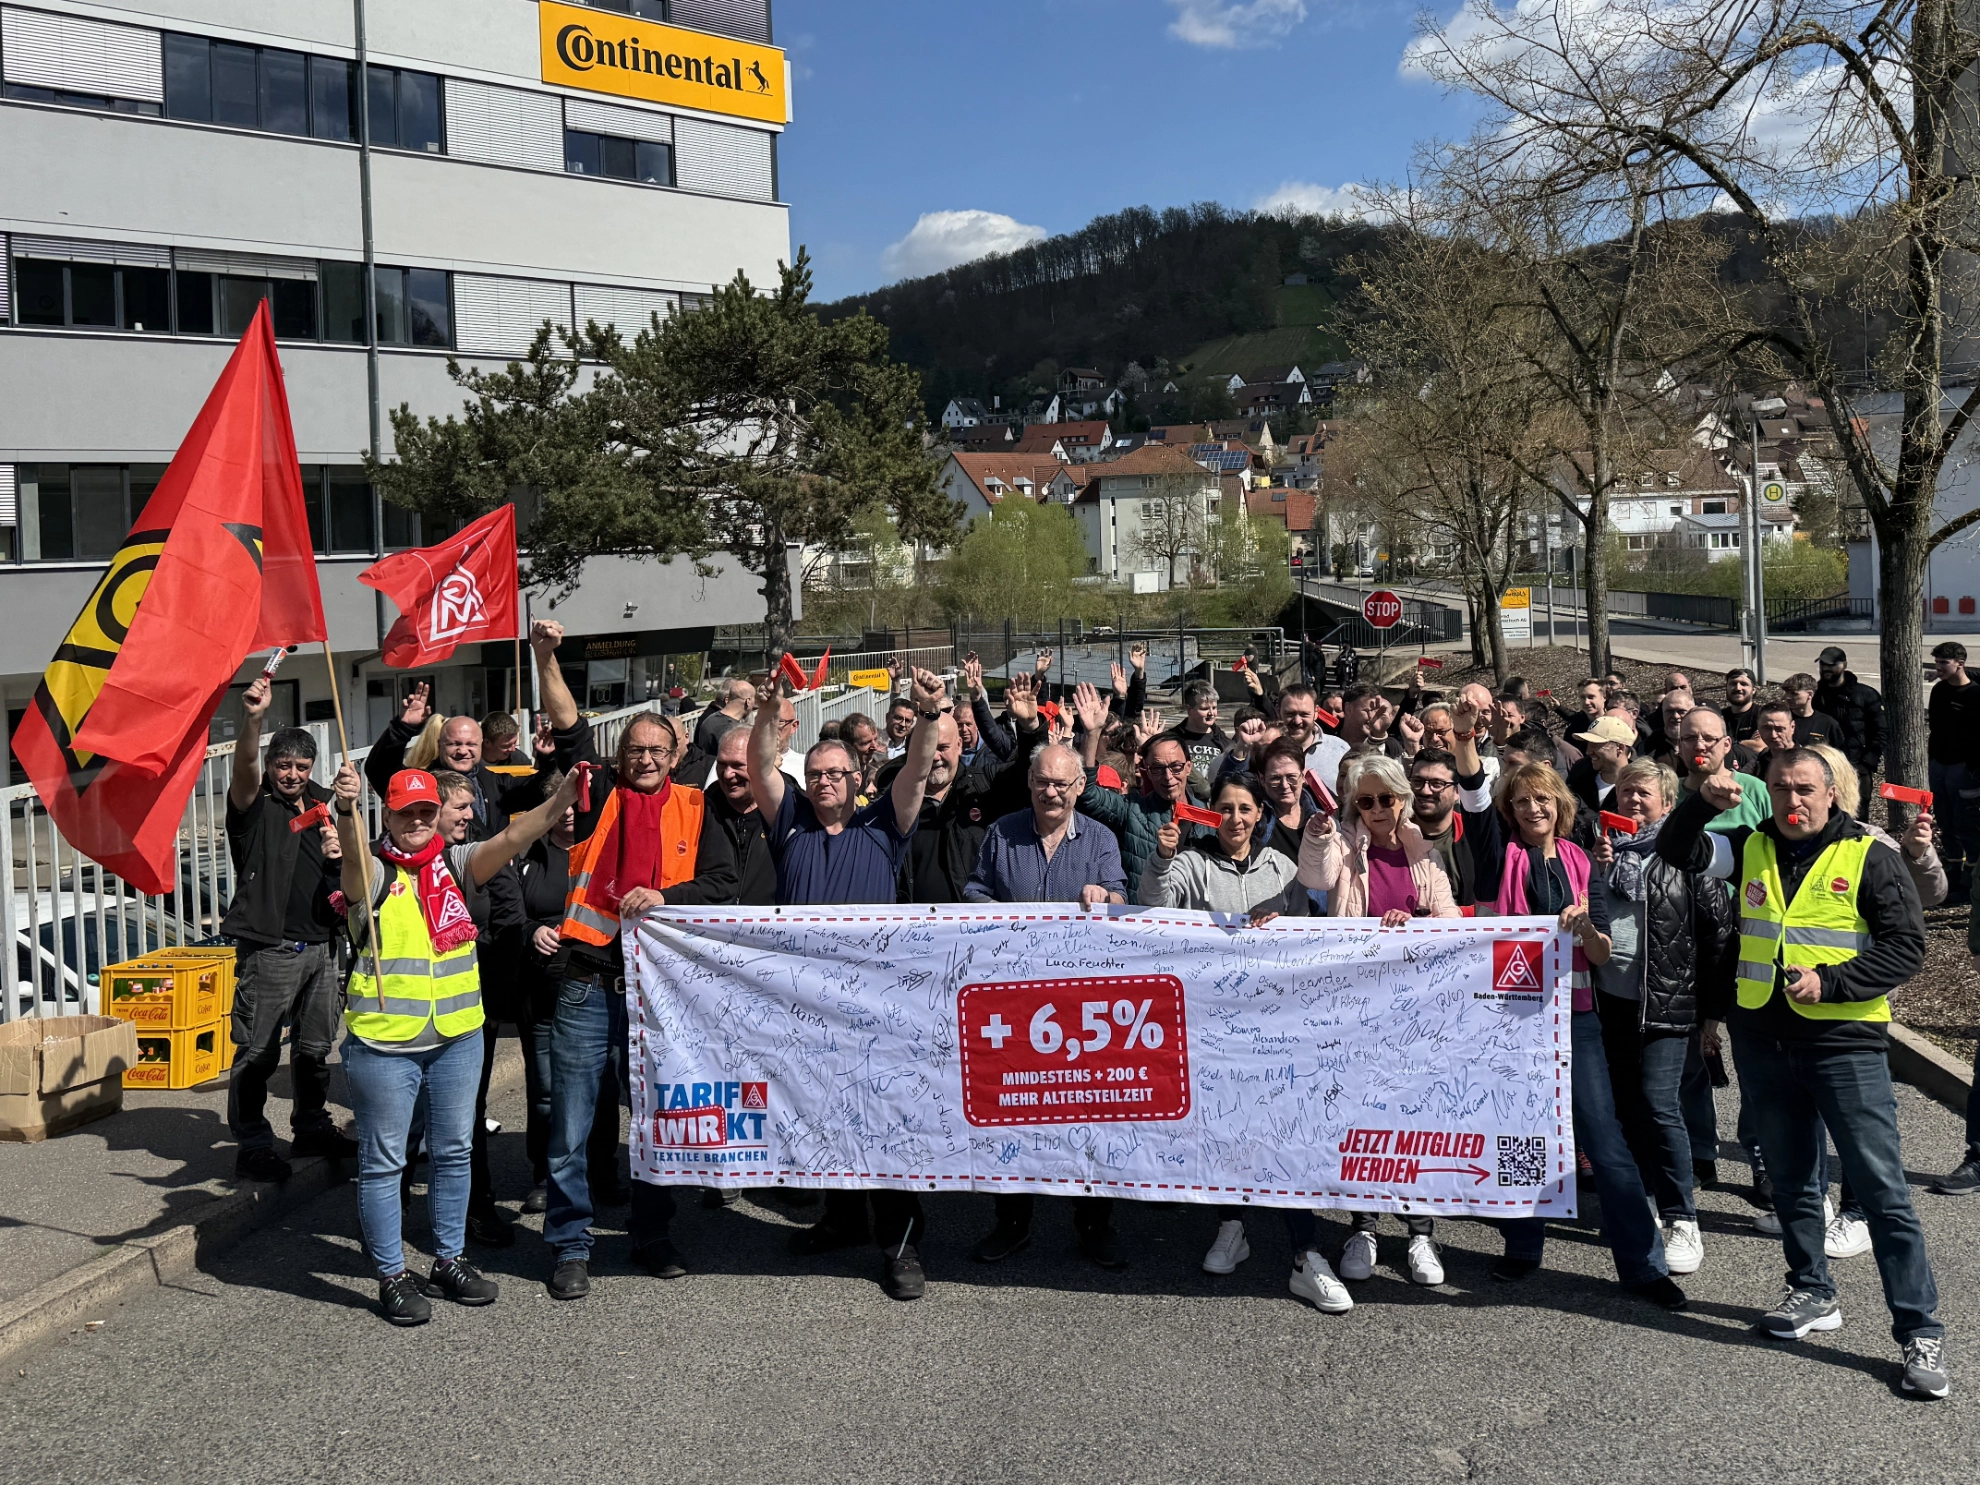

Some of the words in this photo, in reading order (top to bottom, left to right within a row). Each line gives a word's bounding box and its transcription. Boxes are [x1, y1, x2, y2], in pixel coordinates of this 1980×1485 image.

[556, 24, 743, 91] Continental
[1769, 488, 1778, 497] H
[1367, 601, 1399, 617] STOP
[585, 639, 636, 650] ANMELDUNG
[853, 672, 880, 681] Continental
[1046, 958, 1075, 968] Luca
[1079, 957, 1125, 970] Feuchter
[1292, 970, 1347, 995] Leander
[1474, 993, 1543, 1002] Baden-Württemberg
[129, 1007, 168, 1020] Coca-Cola
[197, 1005, 212, 1015] Coke
[981, 1014, 1012, 1049] +
[1029, 999, 1164, 1061] 6,5%
[1252, 1031, 1300, 1045] Alexandros
[127, 1067, 167, 1081] Coca-Cola
[195, 1063, 210, 1074] Coke
[1002, 1069, 1091, 1085] MINDESTENS
[1095, 1072, 1103, 1080] +
[1107, 1068, 1134, 1081] 200
[1139, 1066, 1148, 1081] €
[654, 1082, 740, 1110] TARIF
[999, 1092, 1039, 1106] MEHR
[1042, 1088, 1153, 1105] ALTERSTEILZEIT
[969, 1137, 995, 1155] Denis
[1339, 1129, 1393, 1154] JETZT
[1394, 1131, 1485, 1159] MITGLIED
[653, 1151, 699, 1162] TEXTILE
[704, 1151, 768, 1163] BRANCHEN
[1340, 1156, 1420, 1184] WERDEN
